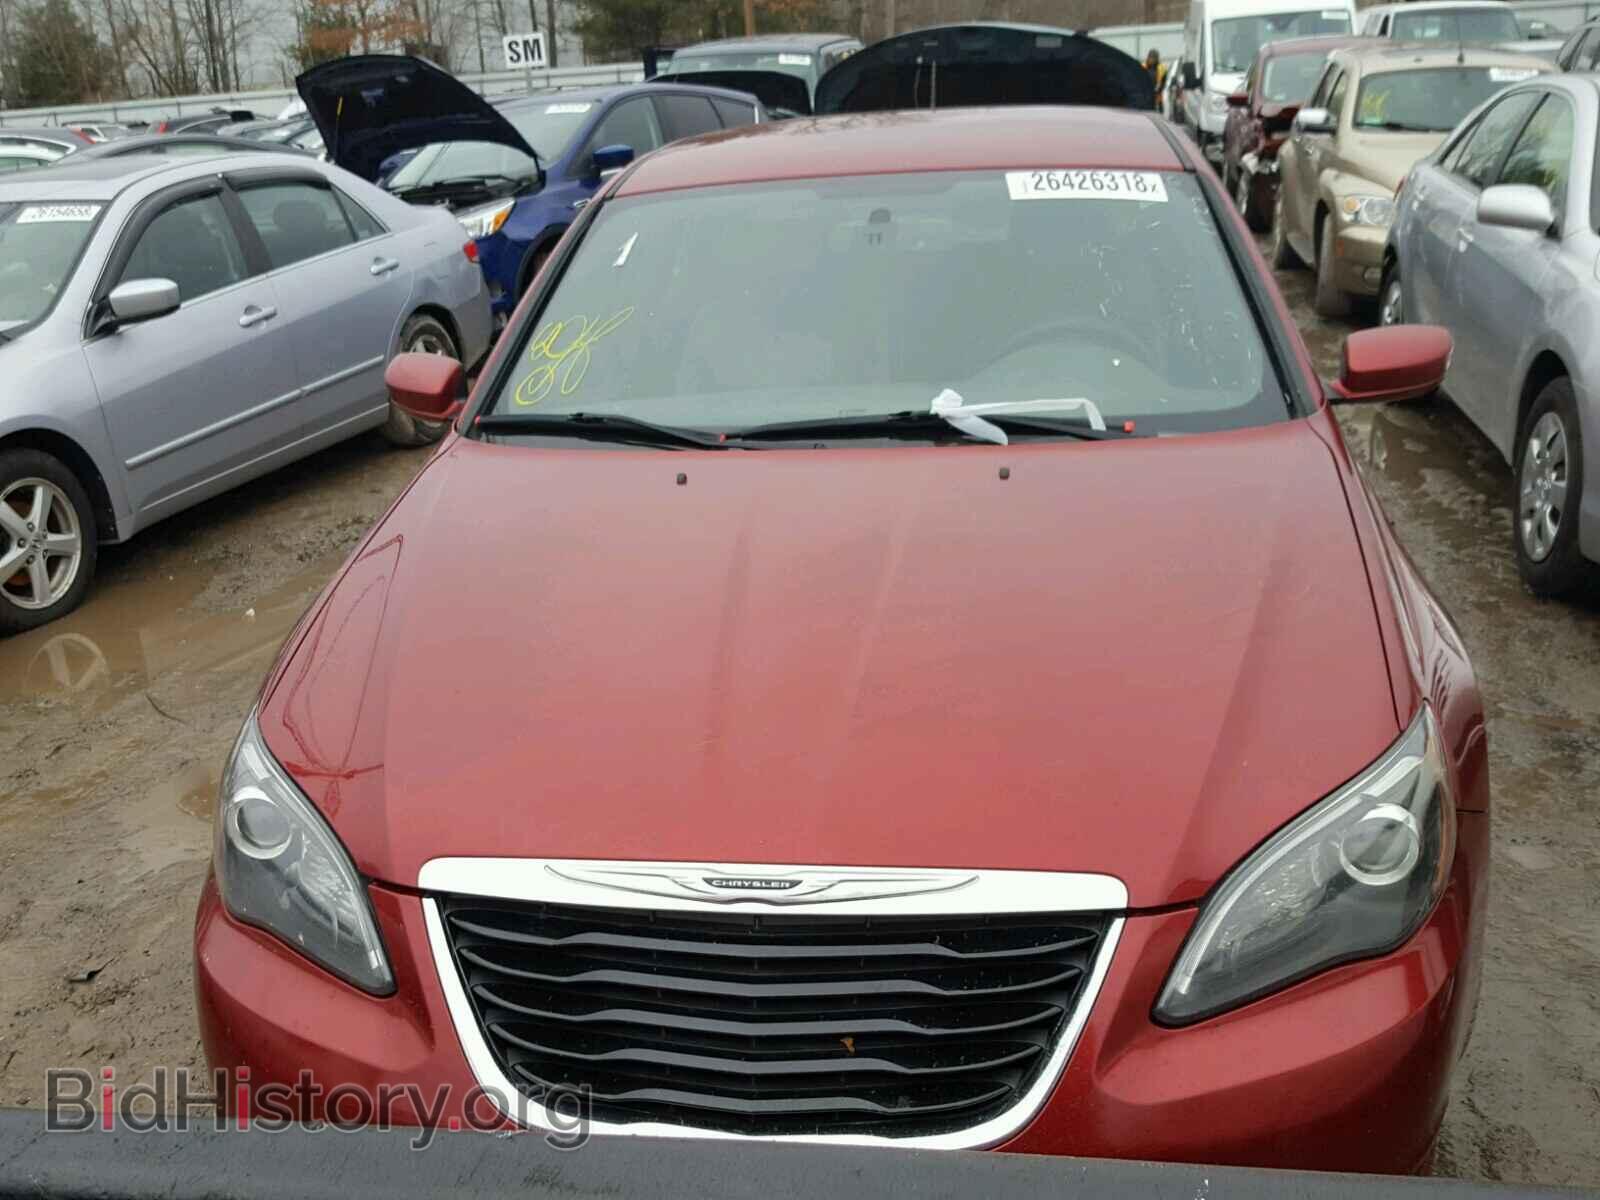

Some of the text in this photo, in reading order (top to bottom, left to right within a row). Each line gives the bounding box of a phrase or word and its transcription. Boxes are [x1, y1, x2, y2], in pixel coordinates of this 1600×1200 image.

[508, 39, 542, 63] SM
[1031, 170, 1148, 193] 26426318
[711, 879, 791, 888] CHRYSLER
